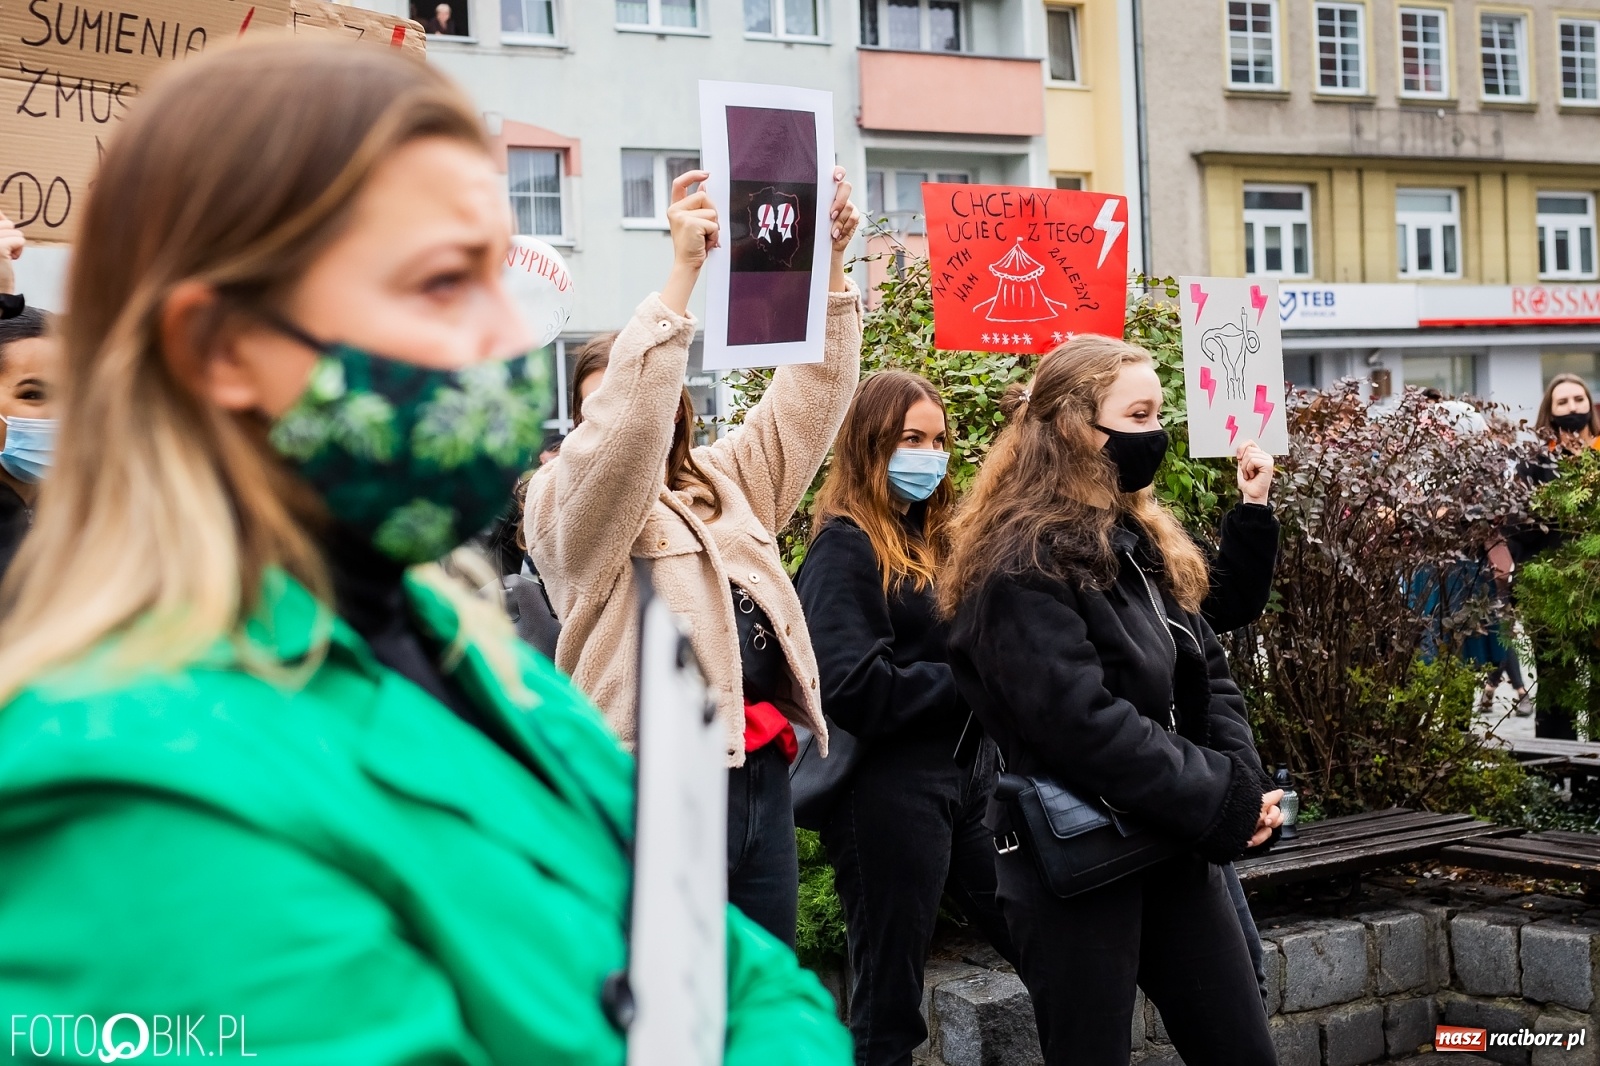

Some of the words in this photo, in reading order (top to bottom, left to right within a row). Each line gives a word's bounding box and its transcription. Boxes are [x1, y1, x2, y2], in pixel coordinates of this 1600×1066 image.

[20, 0, 207, 61] SUMIENIA
[16, 60, 139, 123] ZMUS
[1, 171, 72, 229] DO
[951, 190, 1051, 219] CHCEMY
[946, 220, 1007, 243] UCIEC
[1044, 222, 1095, 244] TEGO
[934, 272, 955, 299] NA
[953, 272, 979, 303] WAM
[1301, 291, 1335, 307] TEB
